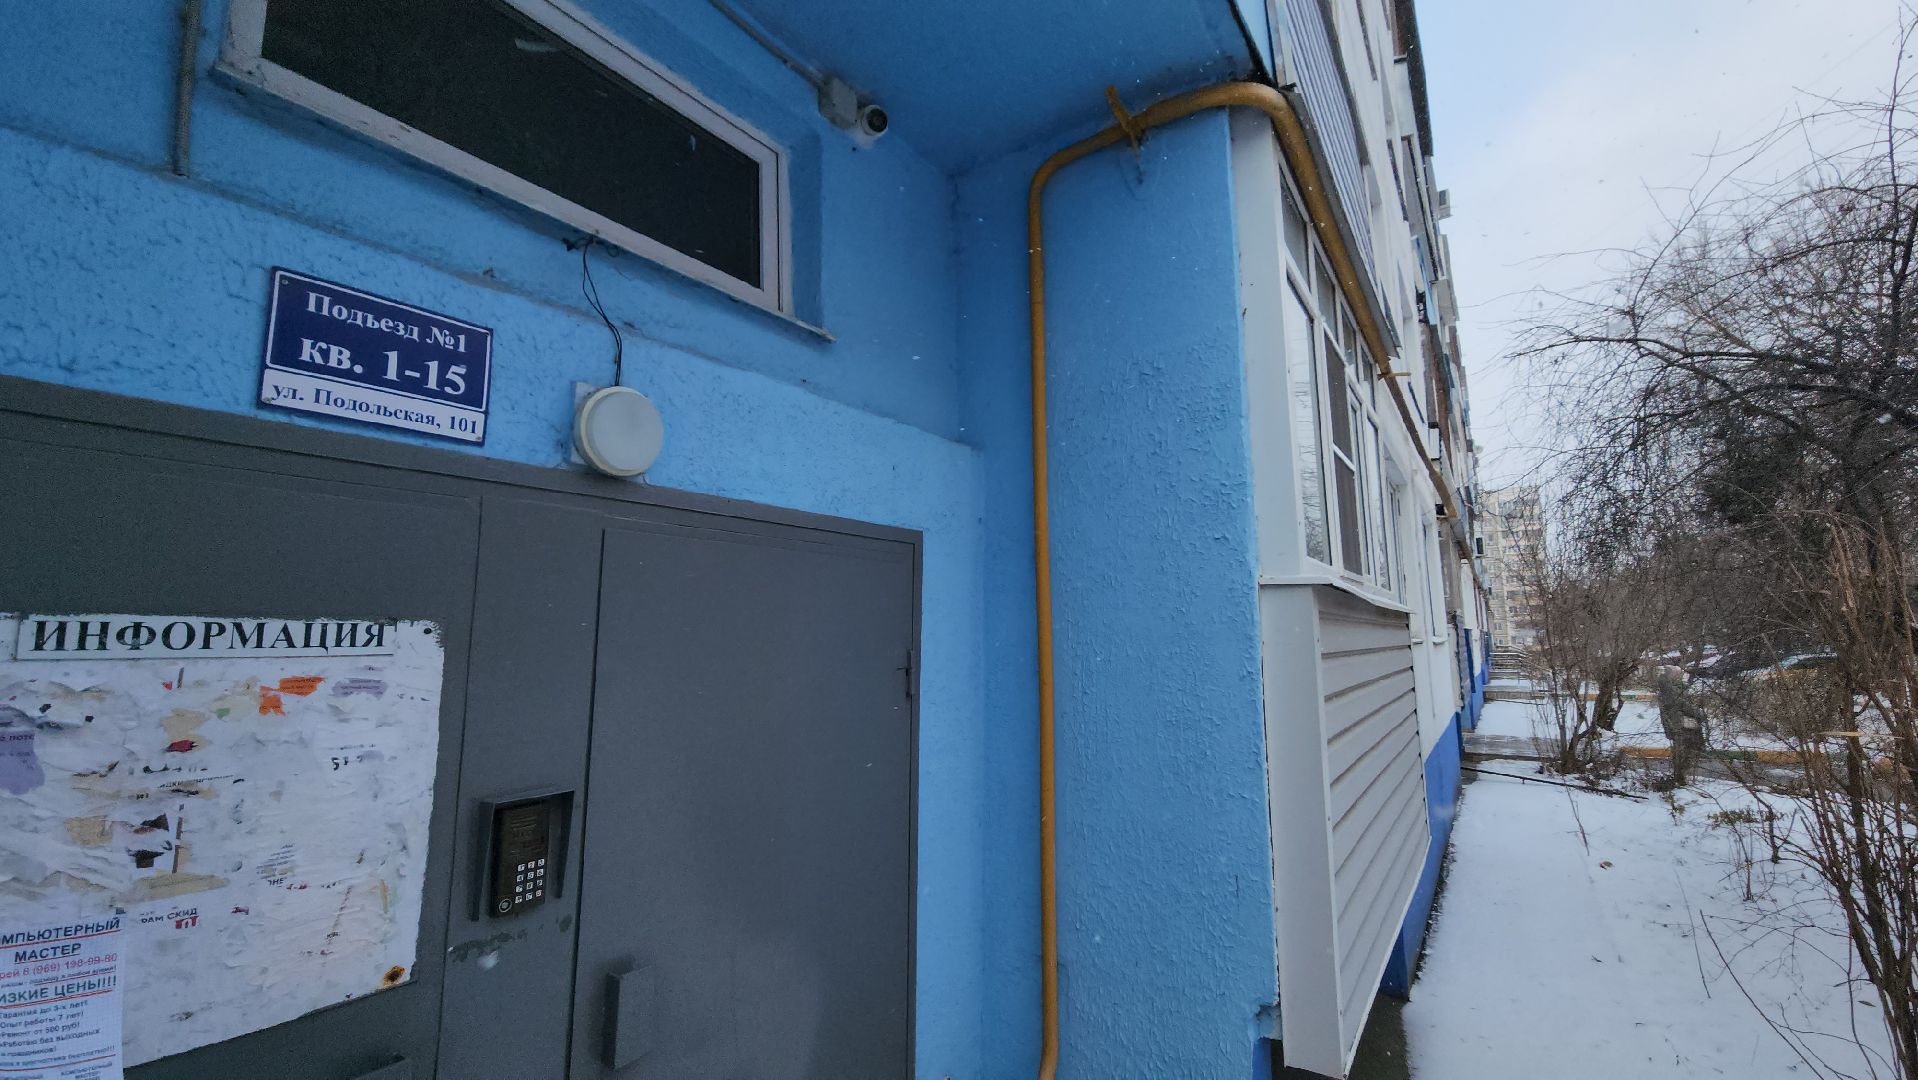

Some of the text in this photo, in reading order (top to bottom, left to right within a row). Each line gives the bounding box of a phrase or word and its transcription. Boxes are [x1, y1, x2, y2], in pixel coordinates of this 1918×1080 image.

[306, 291, 467, 353] Подъезд №1
[381, 350, 467, 396] 1-15
[271, 384, 478, 435] ул. Подольская, 101
[28, 620, 386, 654] ИНФОРМАЦИЯ
[0, 917, 120, 945] МПЬЮТЕРНЫЙ
[14, 943, 81, 963] МАСТЕР
[55, 975, 117, 998] ЦЕНЫ!!!
